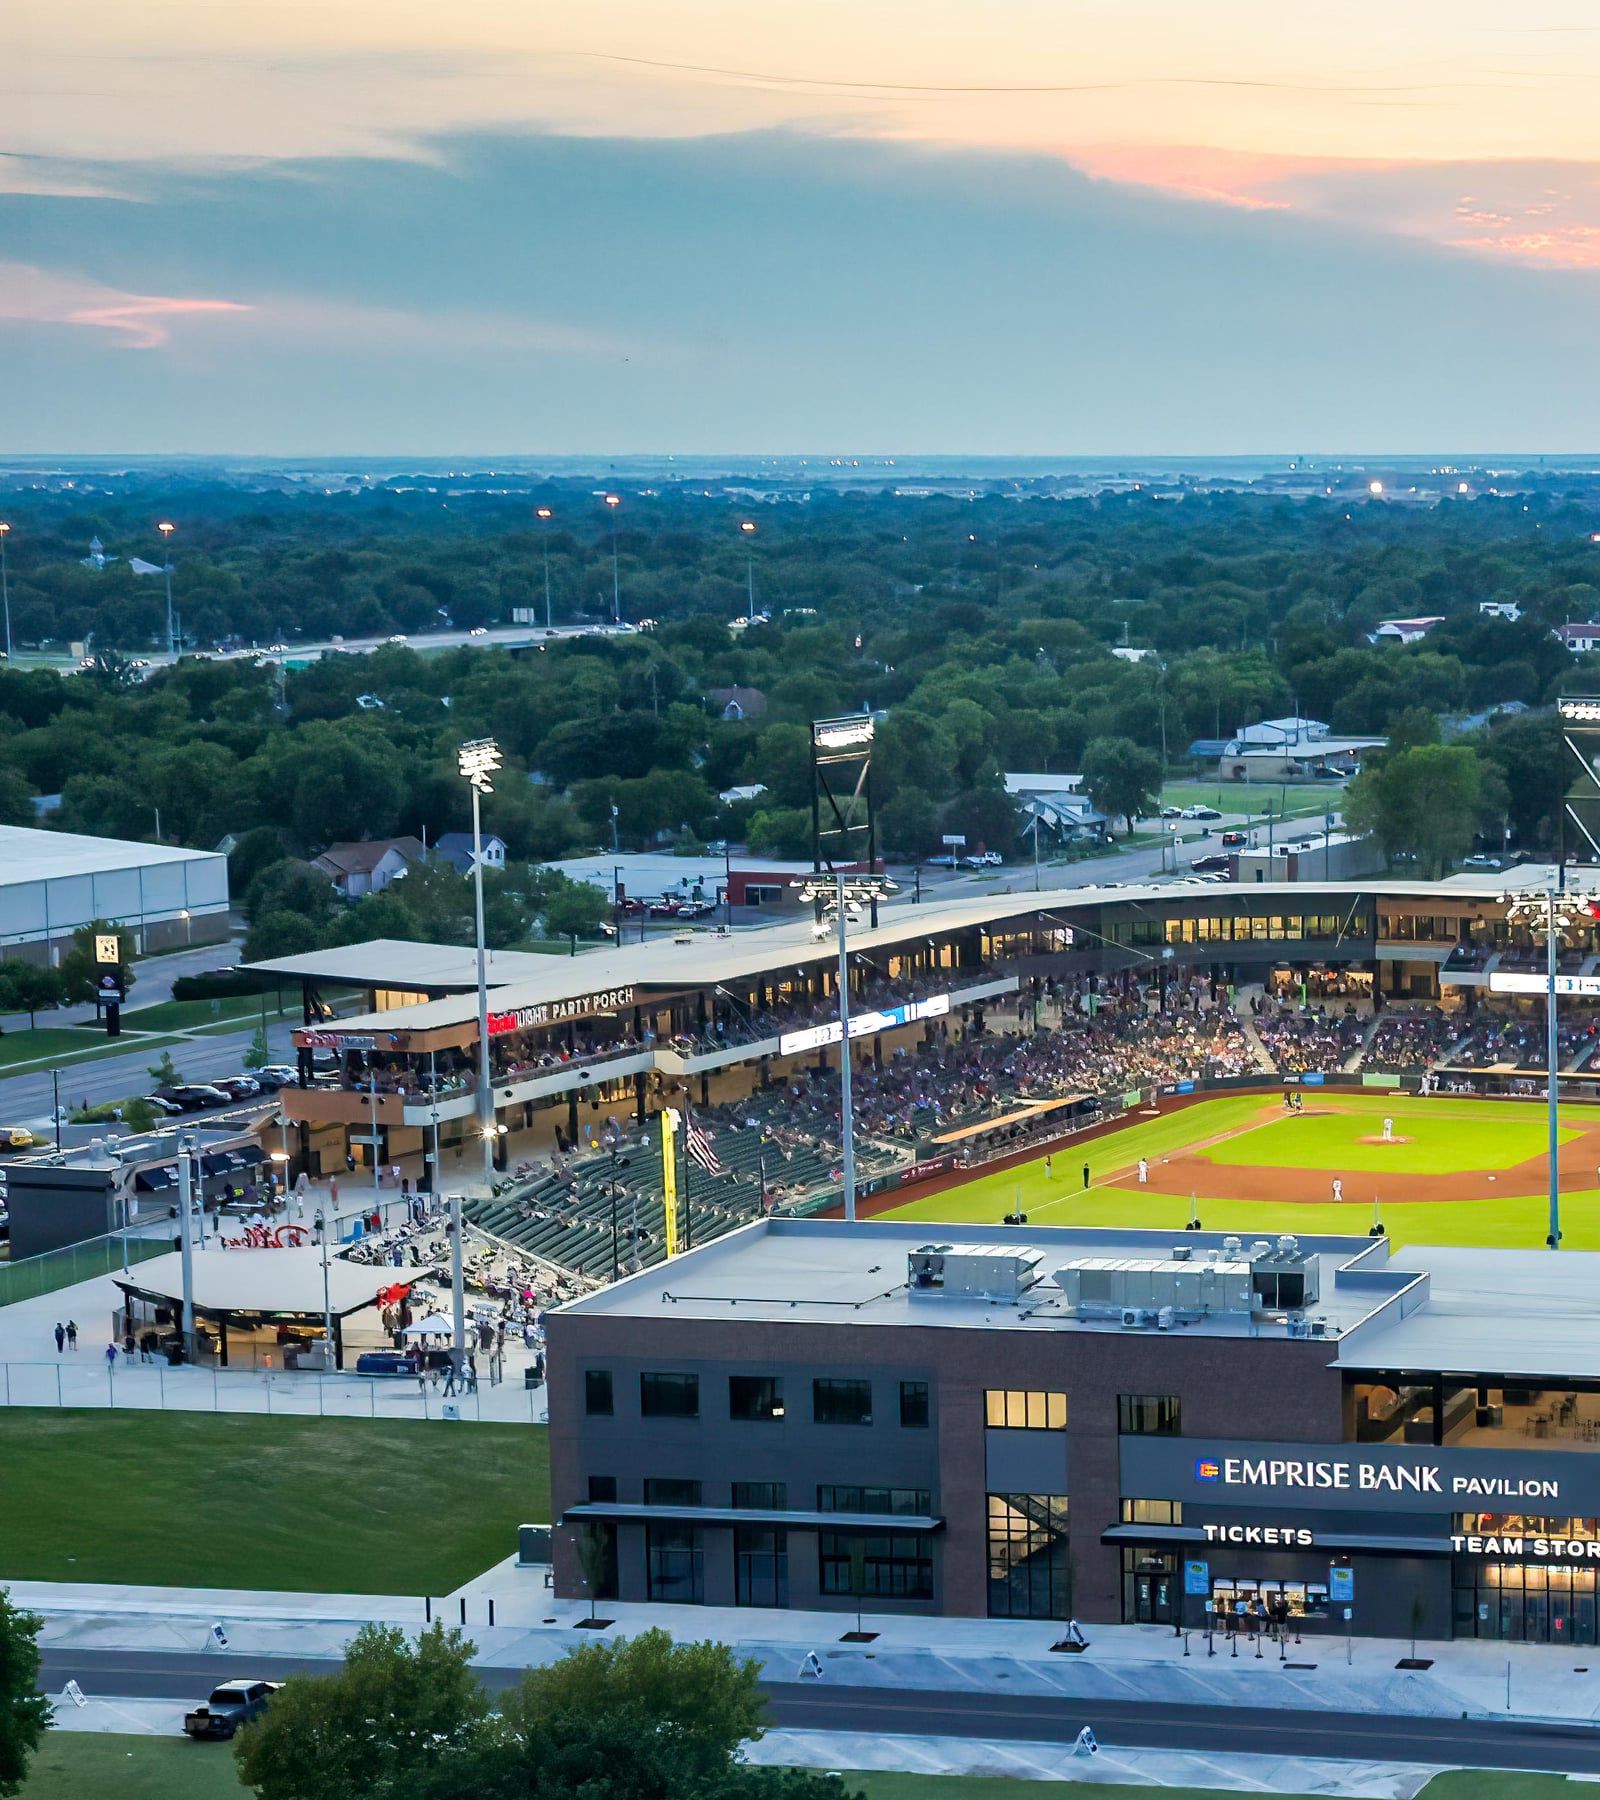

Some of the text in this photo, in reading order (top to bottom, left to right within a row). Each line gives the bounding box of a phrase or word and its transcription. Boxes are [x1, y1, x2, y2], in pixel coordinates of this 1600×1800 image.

[552, 997, 590, 1019] PARTY
[593, 987, 634, 1011] PORCH
[1224, 1458, 1559, 1498] EMPRISE BANK PAVILION
[1202, 1524, 1313, 1545] TICKETS
[1450, 1536, 1523, 1555] TEAM
